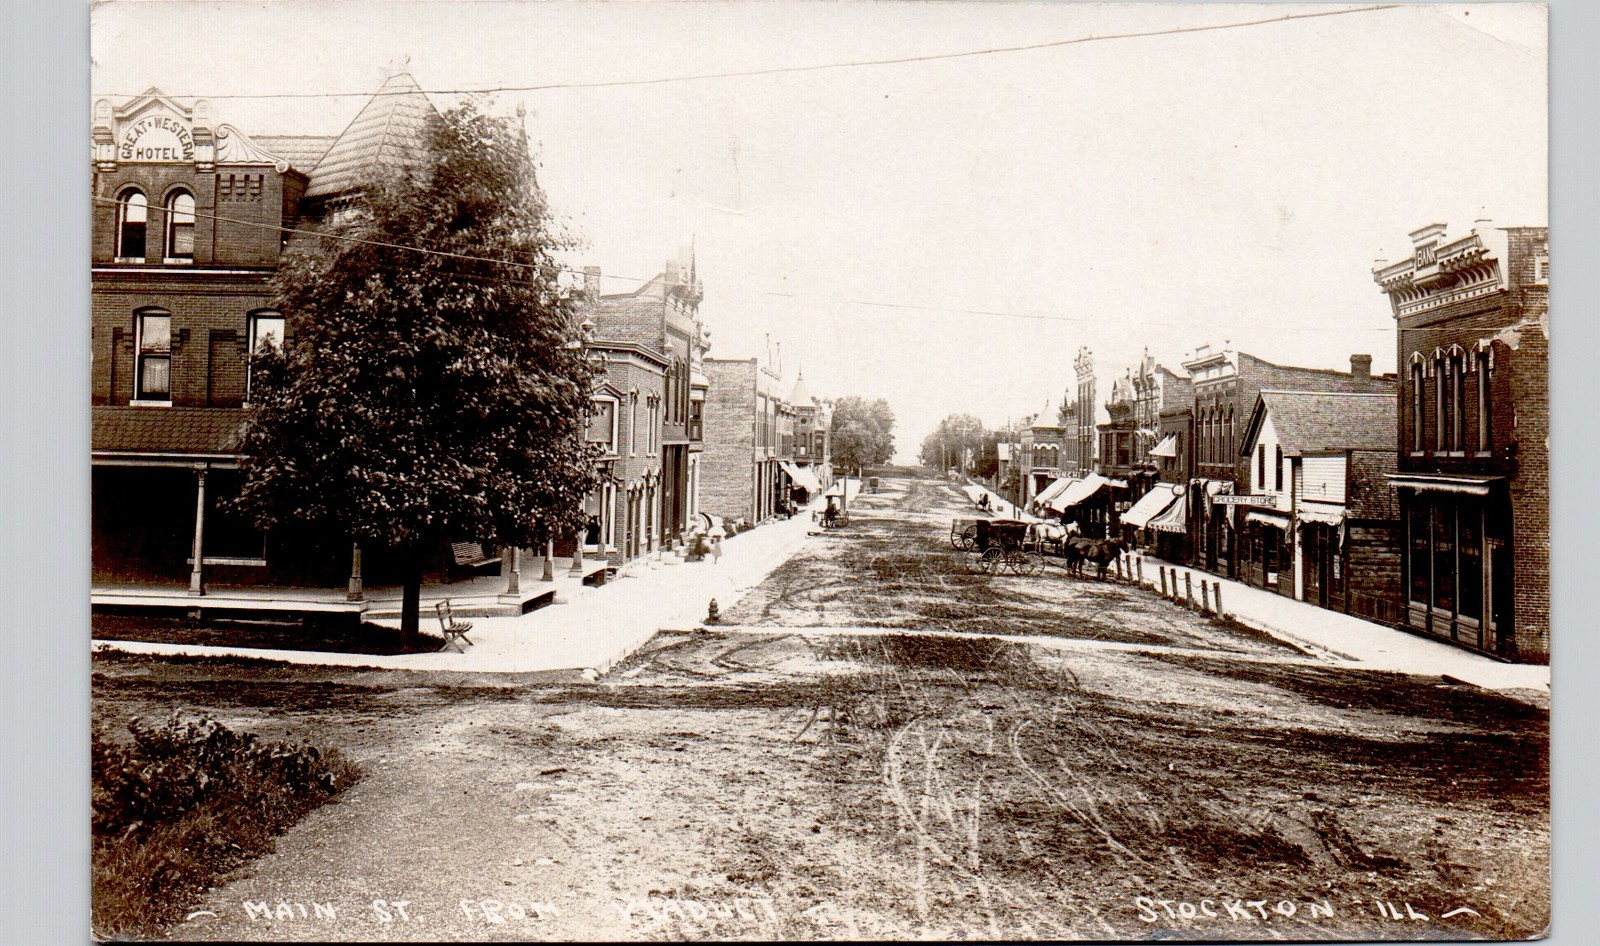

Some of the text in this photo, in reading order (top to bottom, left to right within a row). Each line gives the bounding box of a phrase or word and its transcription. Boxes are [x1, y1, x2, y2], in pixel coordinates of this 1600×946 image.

[154, 117, 194, 160] WESTERN
[136, 148, 179, 160] HOTEL
[1418, 245, 1437, 267] BANK
[1051, 470, 1078, 478] LUNCH
[1214, 496, 1248, 504] GROCERY
